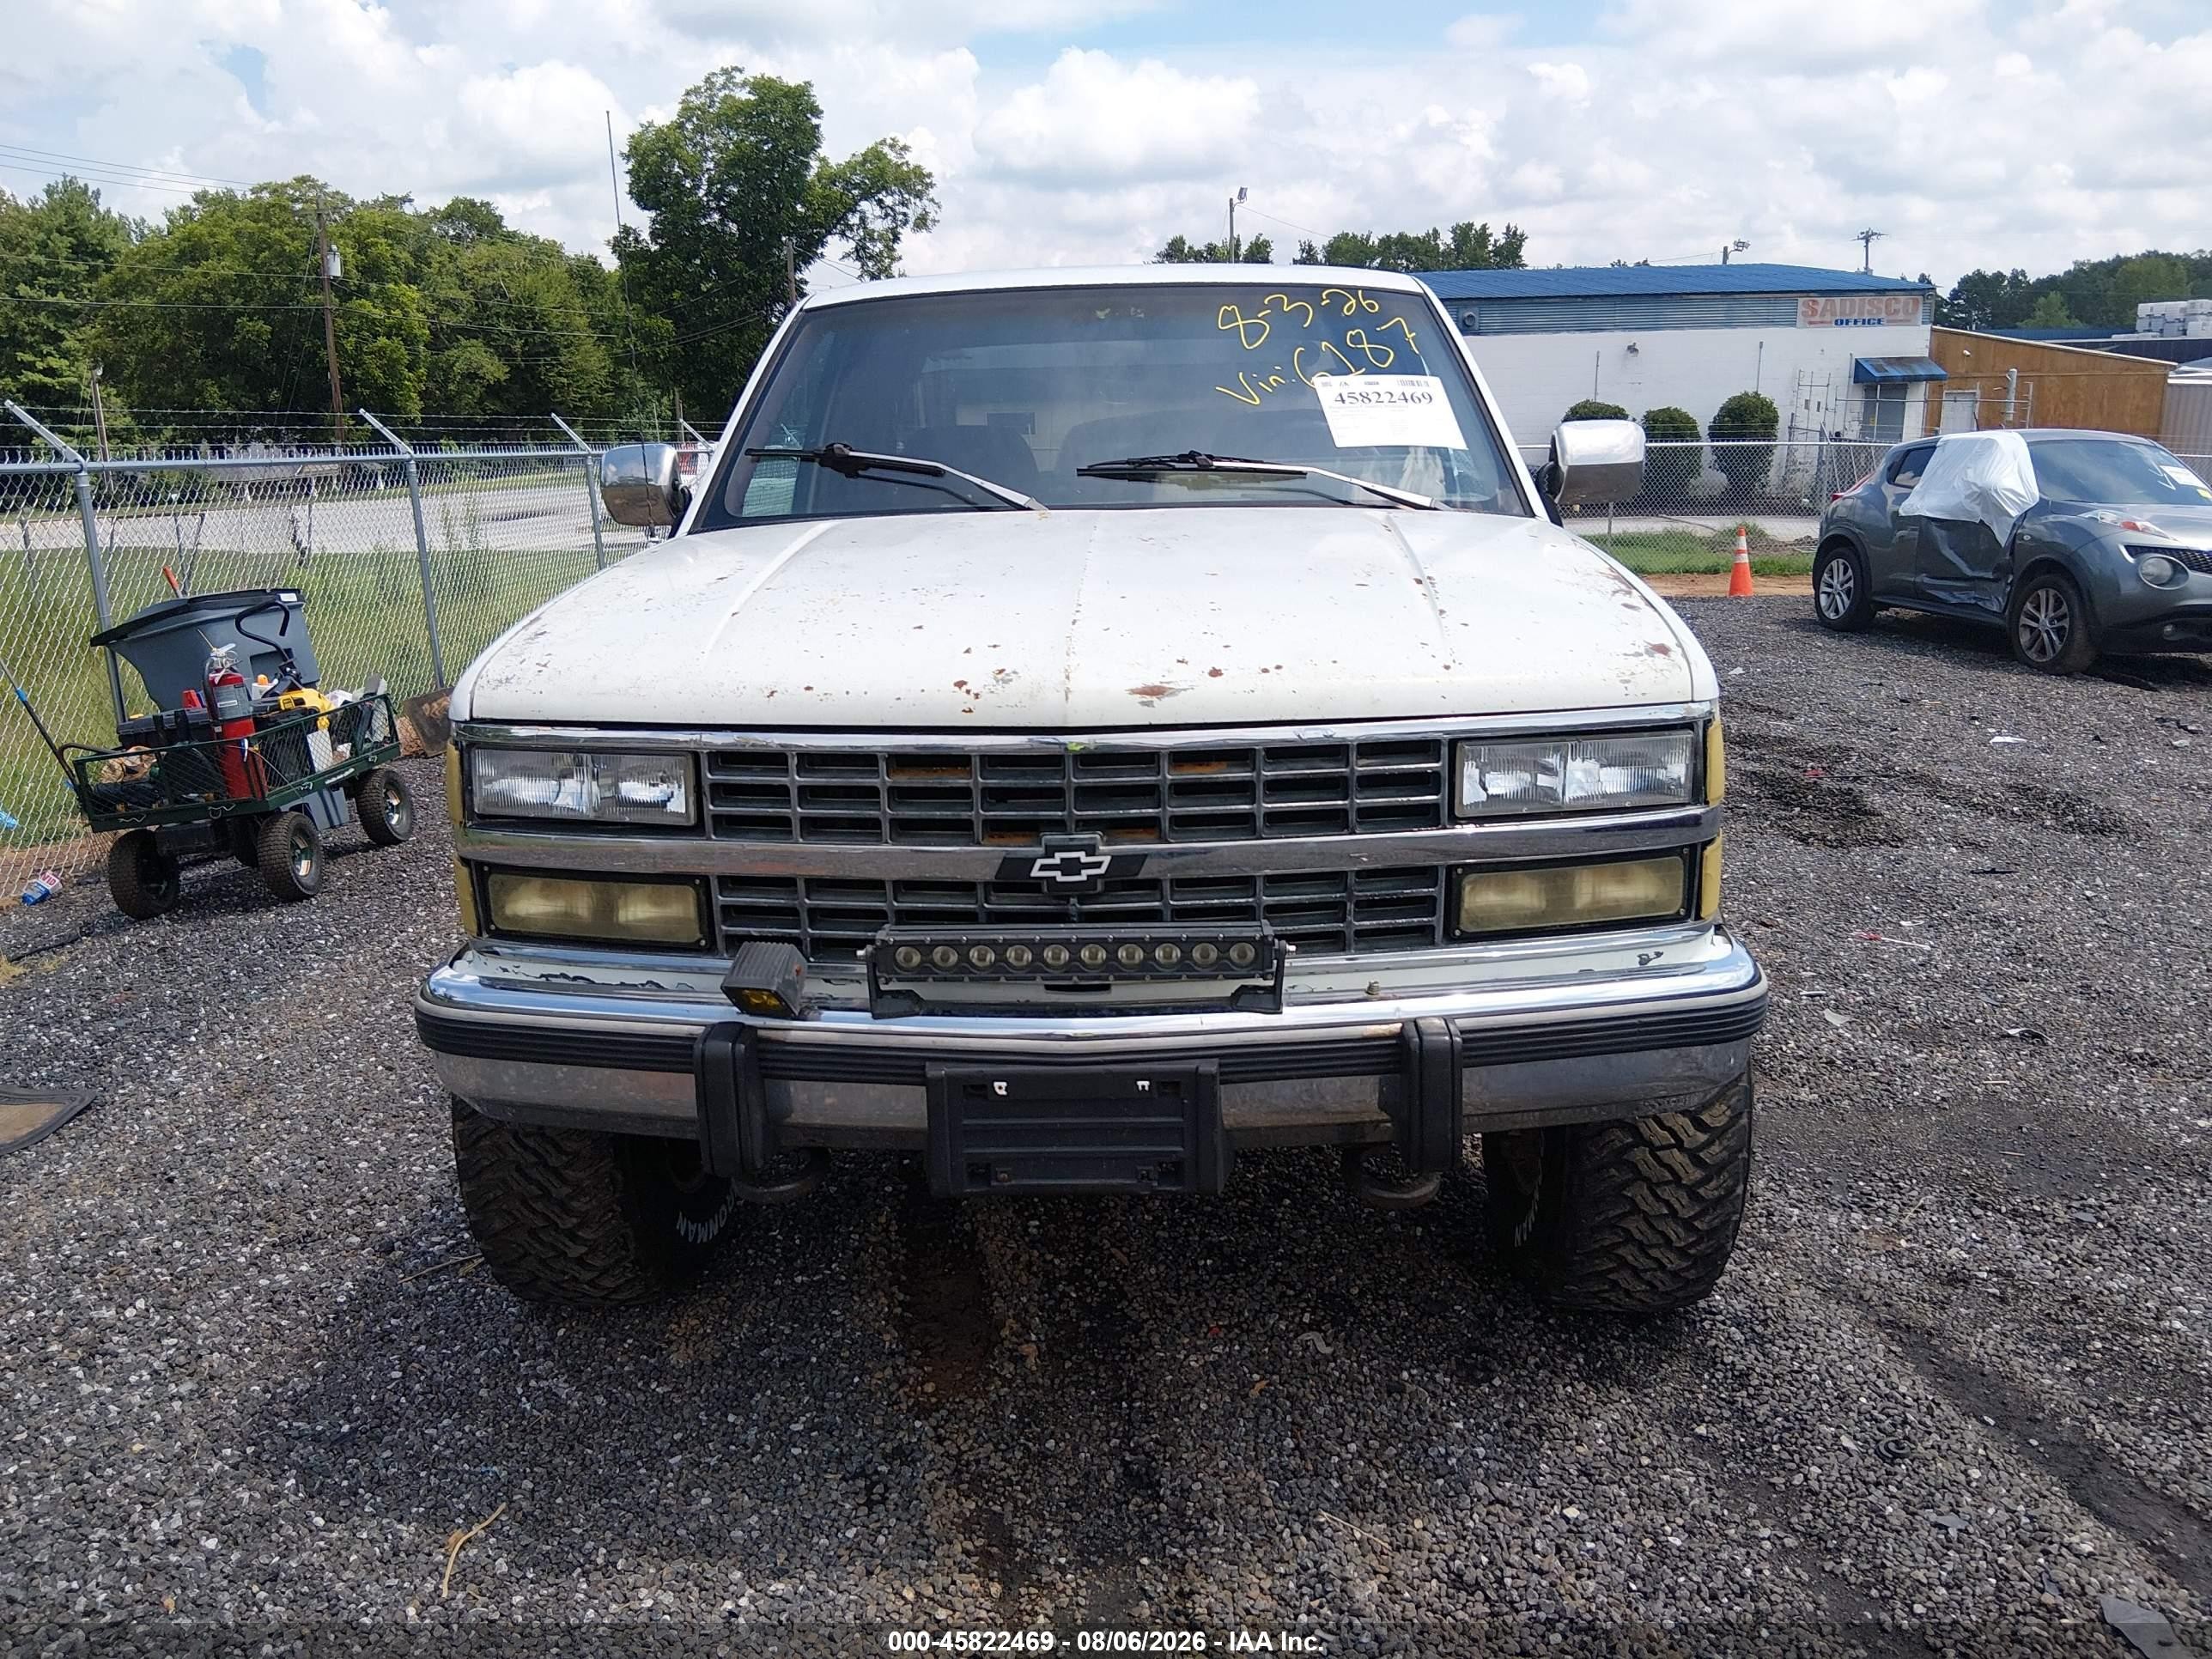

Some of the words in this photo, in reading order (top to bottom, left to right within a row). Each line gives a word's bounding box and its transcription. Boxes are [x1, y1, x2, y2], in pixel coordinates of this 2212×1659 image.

[1802, 298, 1920, 318] SADISCO
[1833, 318, 1885, 326] OFFICE
[1334, 391, 1433, 405] 45822469
